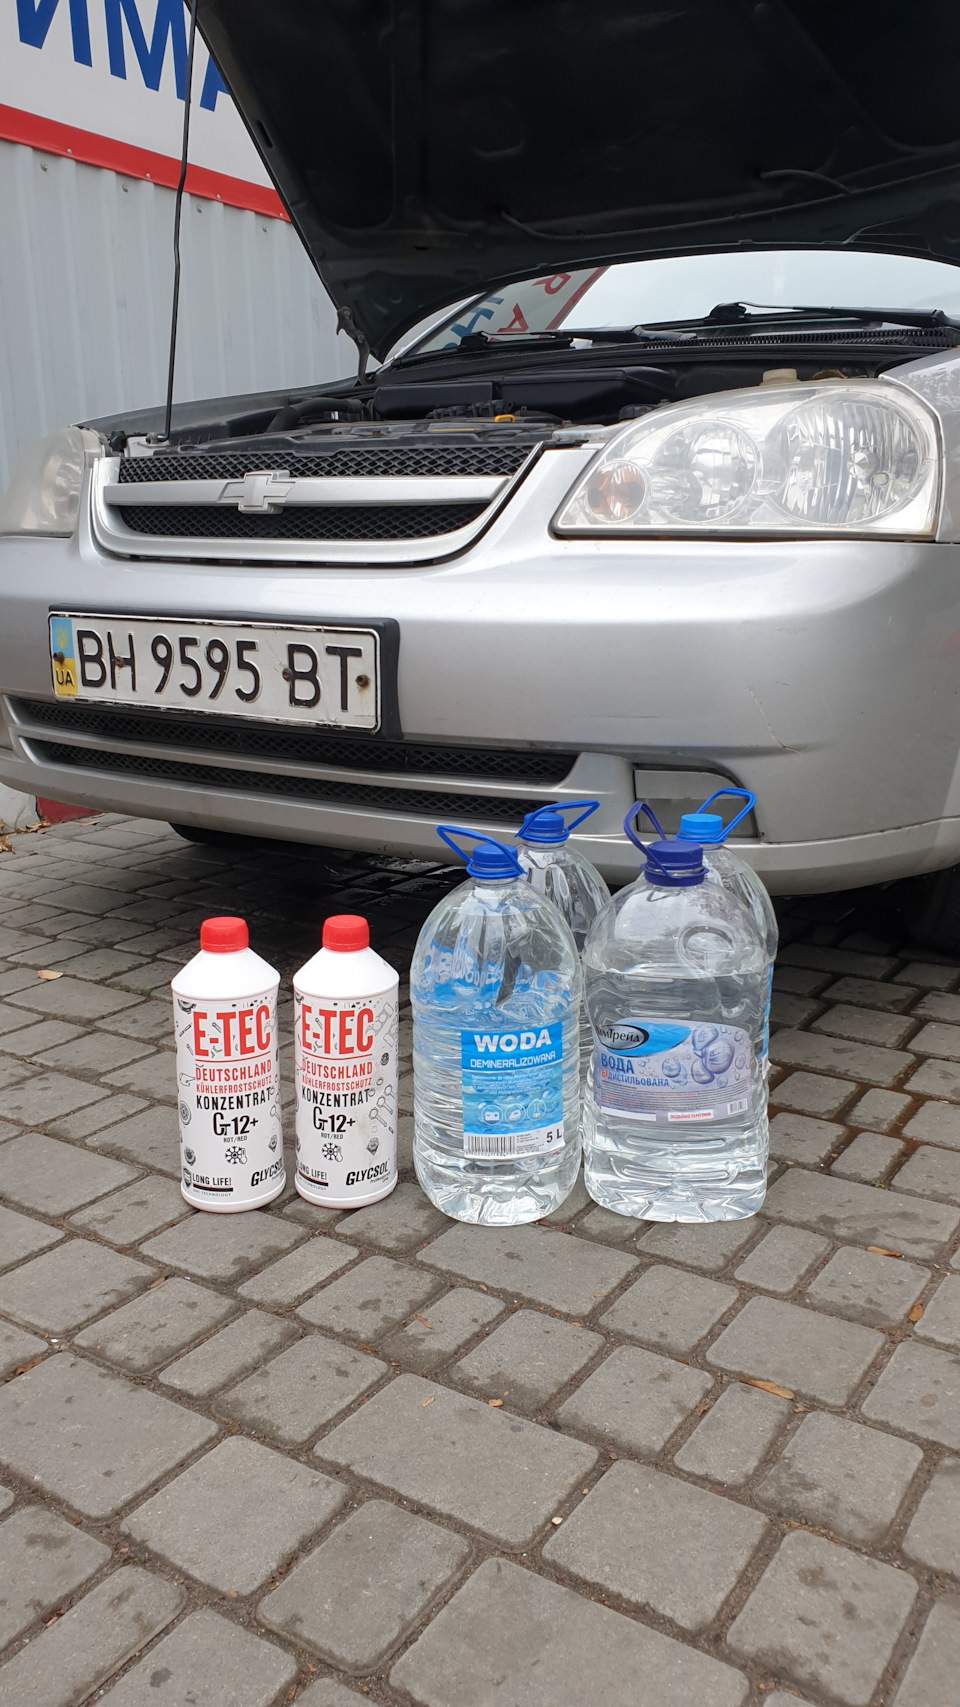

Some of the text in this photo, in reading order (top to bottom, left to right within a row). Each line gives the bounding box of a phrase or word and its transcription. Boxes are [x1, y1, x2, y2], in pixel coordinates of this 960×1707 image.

[56, 668, 75, 687] UA
[77, 629, 363, 712] BH 9595 BT
[193, 1004, 271, 1057] E-TEC
[302, 1003, 374, 1055] E-TEC
[473, 1028, 552, 1053] WODA
[195, 1059, 272, 1082] DEUTSCHLAND
[302, 1058, 373, 1080] DEUTSCHLAND
[470, 1050, 556, 1069] DEMINERALIZOWANA
[601, 1053, 635, 1075] ВОДА
[196, 1074, 272, 1095] KÜHLERFROSTSCHUTZ
[302, 1073, 372, 1092] KÜHLERFROSTSCHUTZ
[196, 1086, 271, 1111] KONZENTRAT
[302, 1085, 371, 1108] KONZENTRAT
[546, 1128, 563, 1143] 5 L
[192, 1173, 232, 1186] LONG LIFE!
[311, 1168, 327, 1180] LIFE!
[346, 1160, 388, 1186] GLYCSOL
